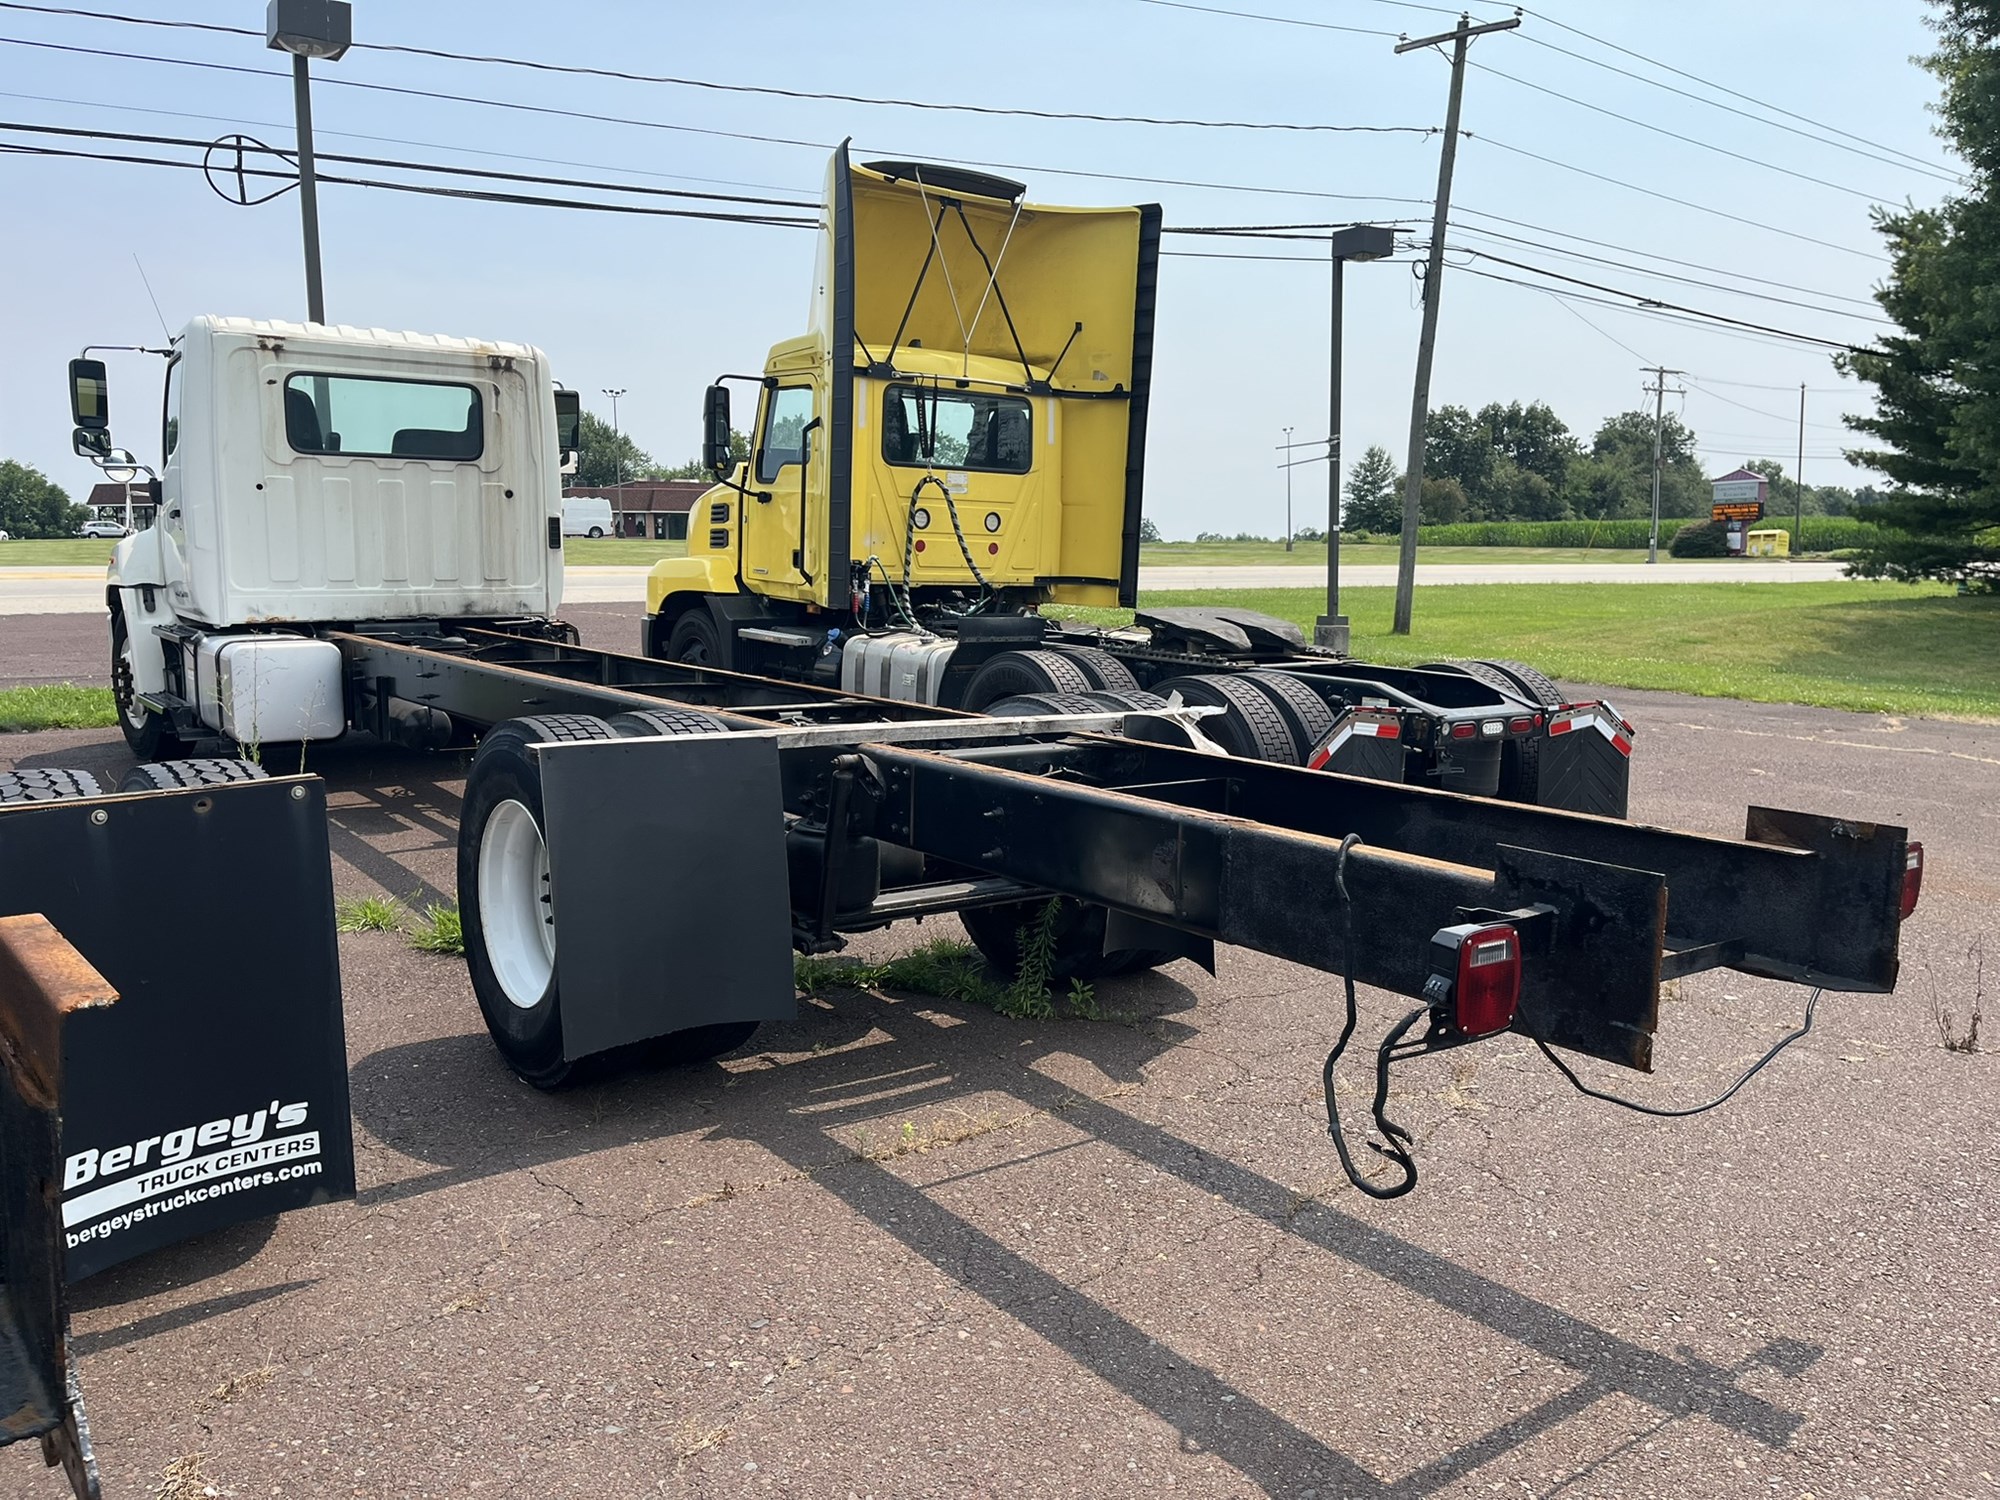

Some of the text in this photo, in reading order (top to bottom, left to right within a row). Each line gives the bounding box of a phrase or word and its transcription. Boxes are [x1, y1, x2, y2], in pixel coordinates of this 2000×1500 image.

[62, 1100, 309, 1191] Bergey's
[137, 1137, 316, 1194] TRUCK CENTERS
[65, 1161, 323, 1249] bergeystruckcenters.com
